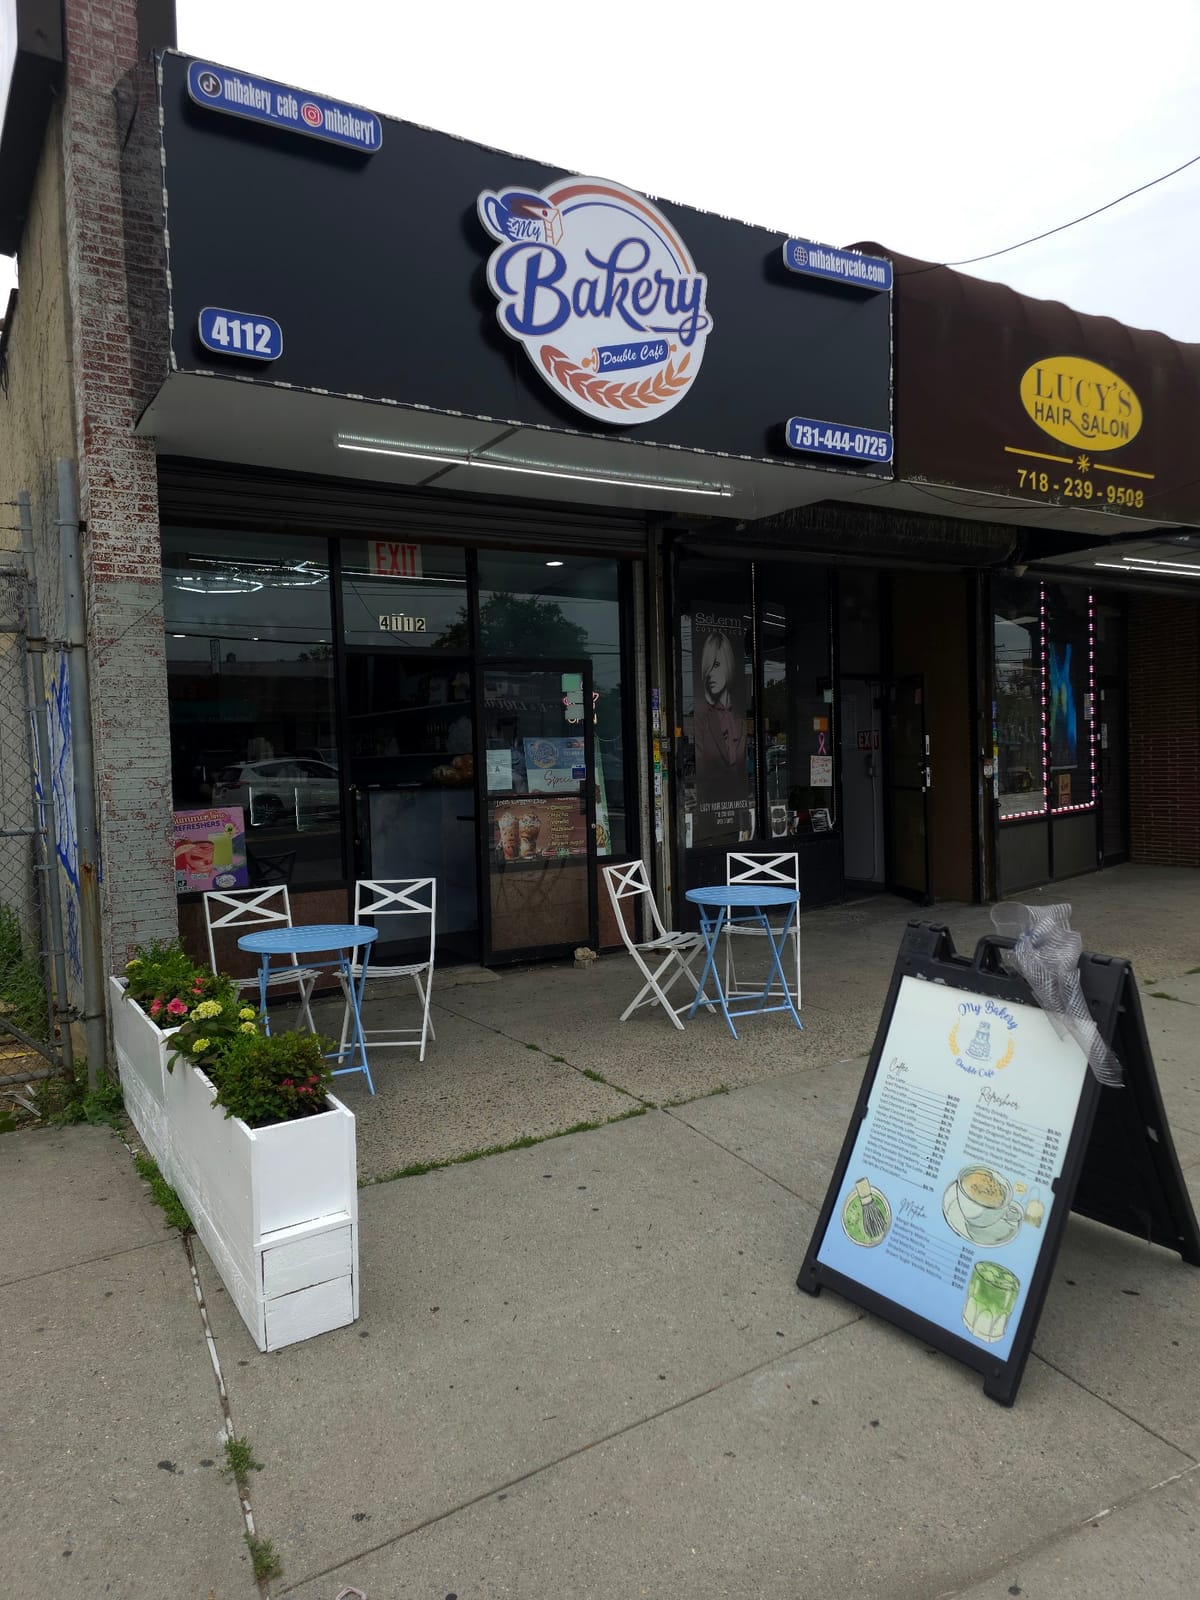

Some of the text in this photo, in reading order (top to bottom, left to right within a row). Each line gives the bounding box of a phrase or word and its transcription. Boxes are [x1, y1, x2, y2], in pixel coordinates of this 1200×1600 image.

[224, 77, 375, 145] mibakery_cafe mibakery1
[513, 219, 541, 241] My
[809, 250, 885, 284] mibakerycafe.com
[496, 237, 709, 347] Bakery
[212, 316, 272, 354] 4112
[602, 346, 637, 365] Double
[1034, 368, 1132, 418] LUCY'S
[795, 425, 887, 457] 731-444-0725
[1081, 412, 1129, 439] SALON
[375, 543, 416, 577] EXIT
[381, 616, 425, 631] 4112
[958, 1000, 1018, 1030] My Bakery
